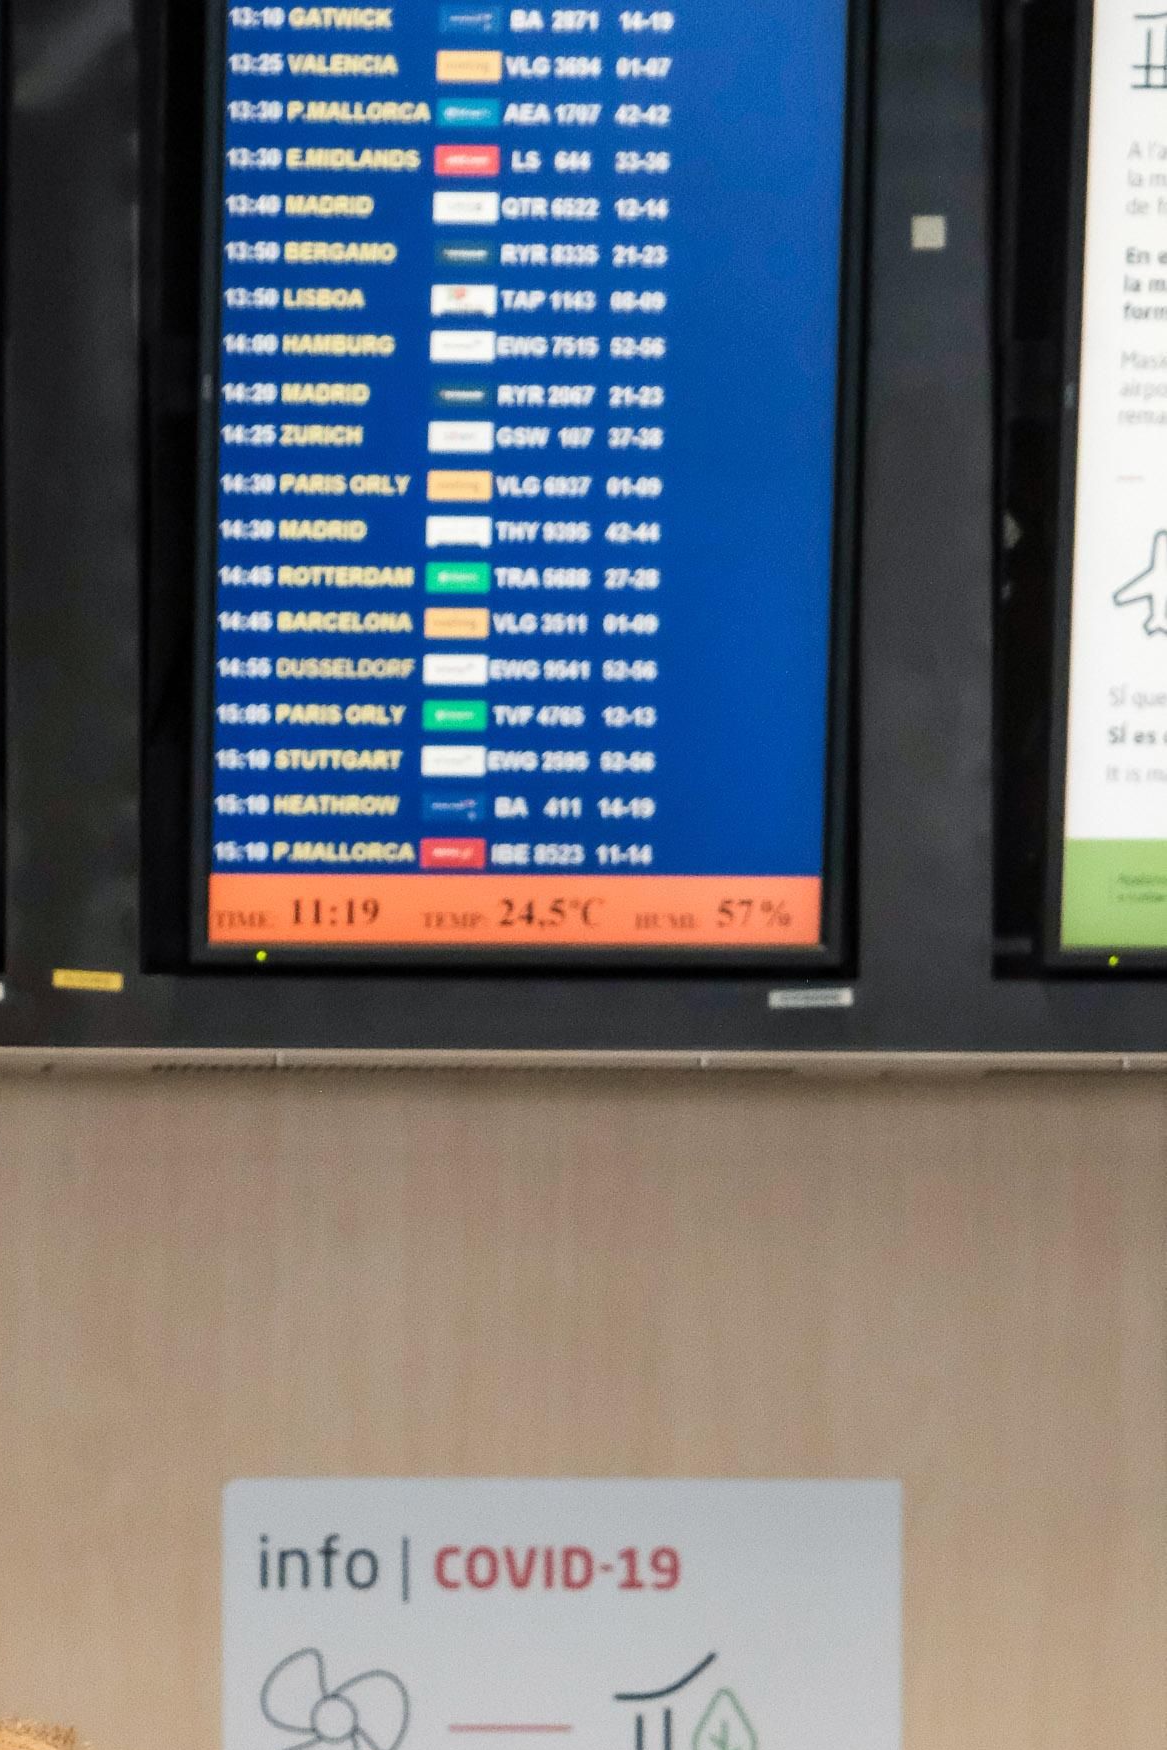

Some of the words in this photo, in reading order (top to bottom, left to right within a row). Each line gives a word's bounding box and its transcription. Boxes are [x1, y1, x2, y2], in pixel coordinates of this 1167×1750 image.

[289, 8, 391, 29] GATWICK
[510, 10, 543, 31] BA
[288, 54, 398, 74] VALENCIA
[506, 56, 550, 77] VLG
[287, 101, 430, 122] P.MALLORCA
[504, 103, 550, 124] AEA
[286, 148, 421, 170] E.MIDLANDS
[512, 151, 541, 171] LS
[285, 195, 374, 216] MADRID
[284, 242, 397, 262] BERGAMO
[501, 244, 547, 263] RYR
[1125, 246, 1151, 266] En
[1123, 274, 1142, 294] la
[284, 288, 364, 308] LISBOA
[501, 290, 545, 309] TAP
[283, 335, 394, 355] HAMBURG
[497, 336, 548, 356] EWG
[281, 383, 370, 404] MADRID
[498, 385, 544, 404] RYR
[280, 425, 362, 445] ZURICH
[280, 474, 346, 494] PARIS
[349, 474, 410, 494] ORLY
[496, 476, 540, 495] VLG
[279, 520, 367, 540] MADRID
[496, 522, 539, 540] THY
[278, 566, 414, 586] ROTTERDAM
[495, 568, 539, 587] TRA
[277, 612, 412, 632] BARCELONA
[493, 614, 537, 633] VLG
[276, 658, 414, 678] DUSSELDORF
[489, 660, 539, 679] EWG
[276, 704, 342, 724] PARIS
[345, 704, 404, 724] ORLY
[275, 750, 402, 769] STUTTGART
[487, 751, 537, 770] EWG
[274, 795, 399, 814] HEATHROW
[495, 797, 527, 817] BA
[545, 798, 581, 816] 411
[273, 842, 414, 861] P.MALLORCA
[291, 898, 381, 925] 11:19
[259, 1533, 379, 1590] info
[434, 1546, 681, 1591] COVID-19
